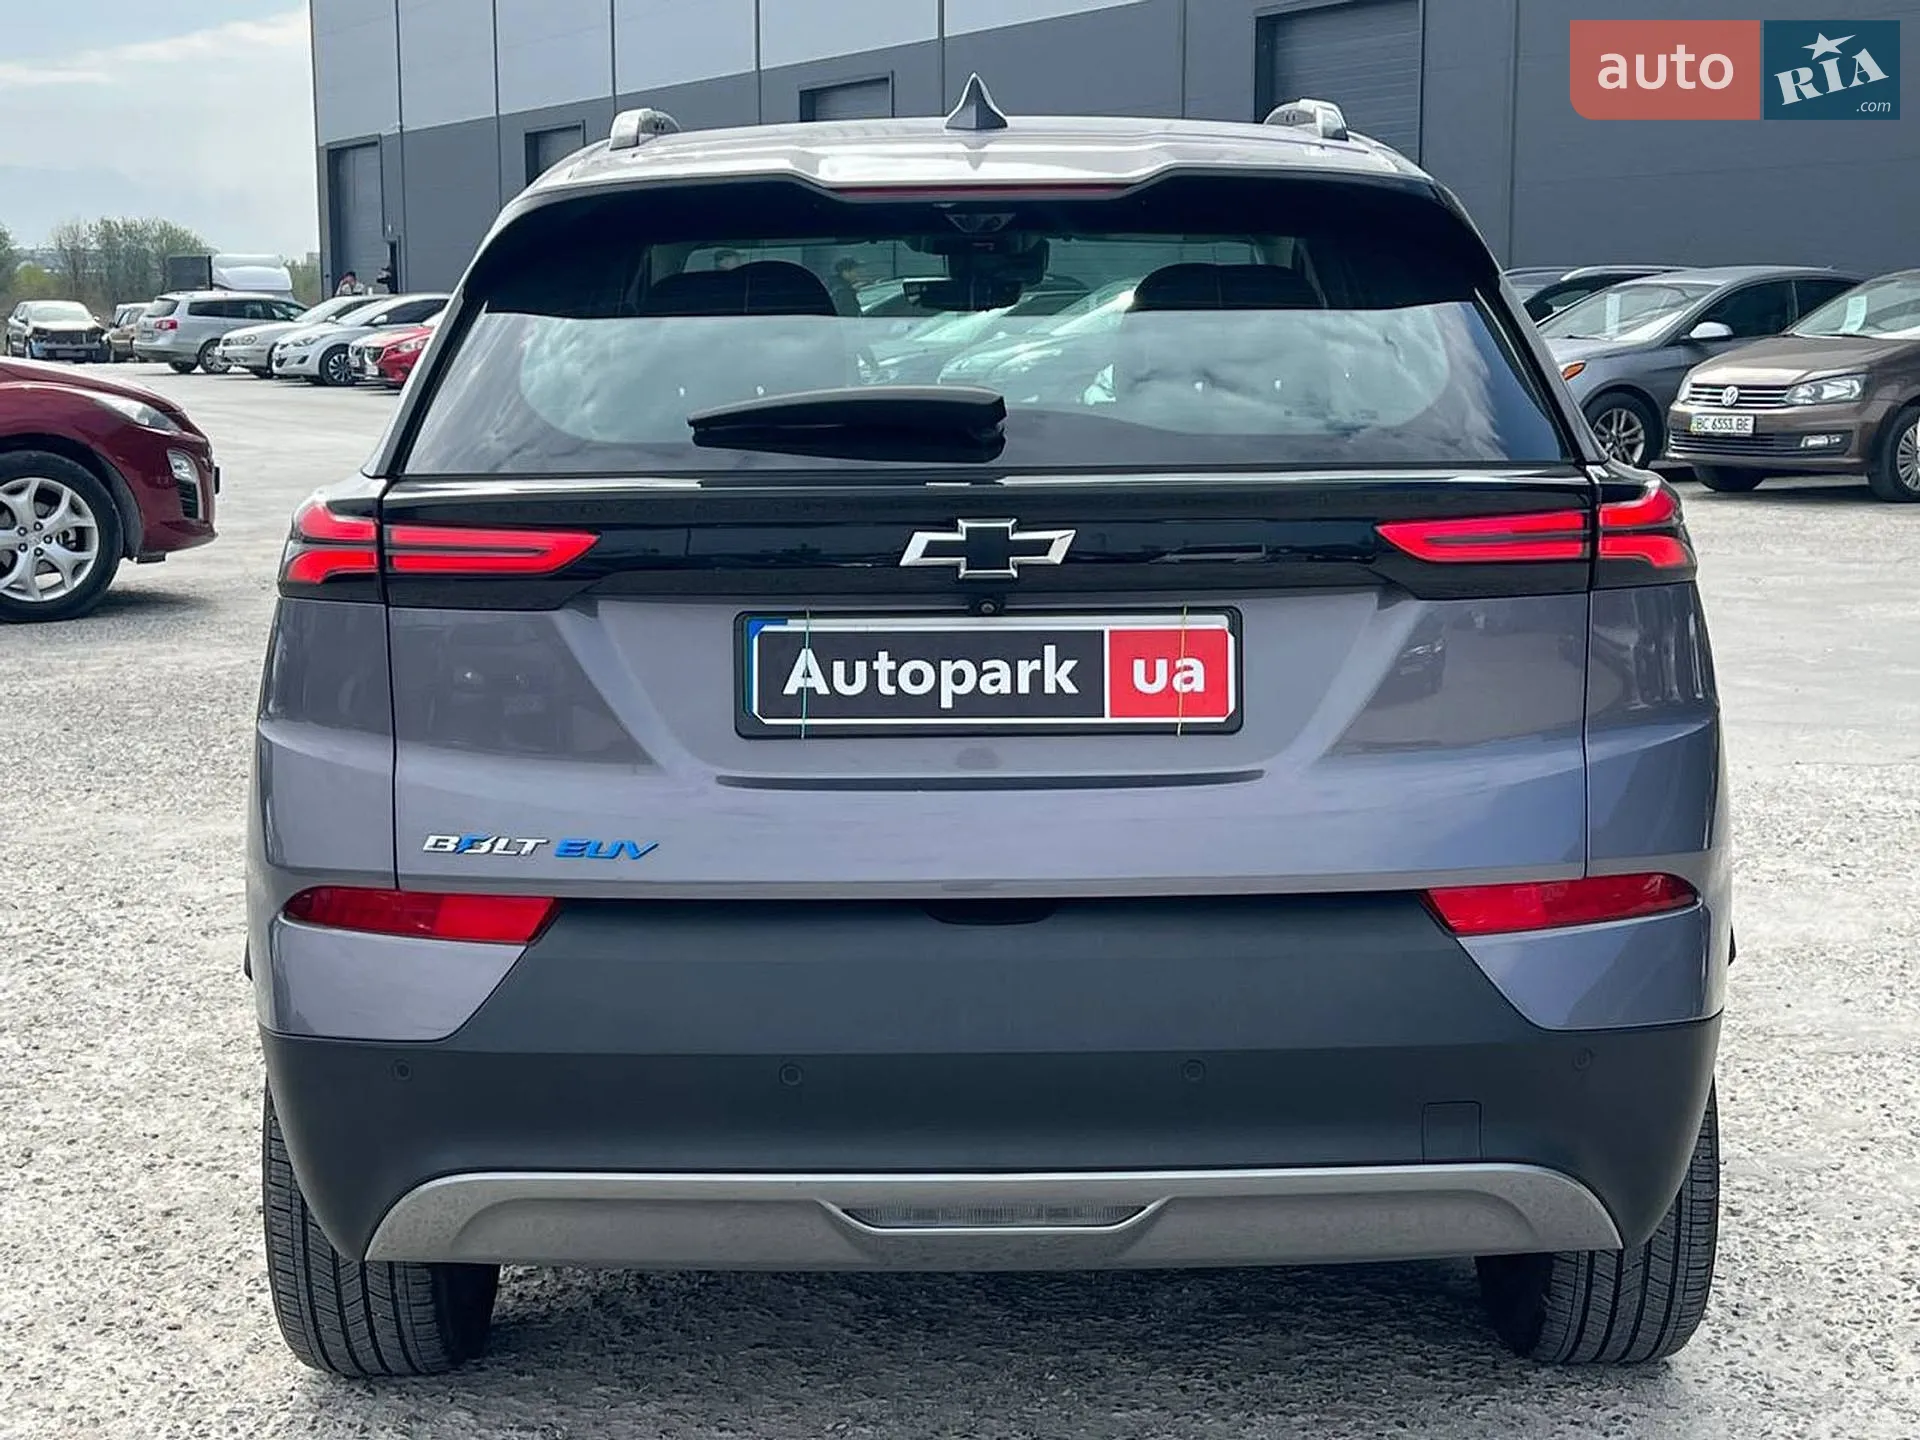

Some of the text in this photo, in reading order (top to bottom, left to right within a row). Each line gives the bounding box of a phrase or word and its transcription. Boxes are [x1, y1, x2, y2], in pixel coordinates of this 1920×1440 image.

[1736, 418, 1750, 431] BE
[782, 644, 1206, 709] Autopark ua
[422, 832, 660, 860] BOLT EUV
